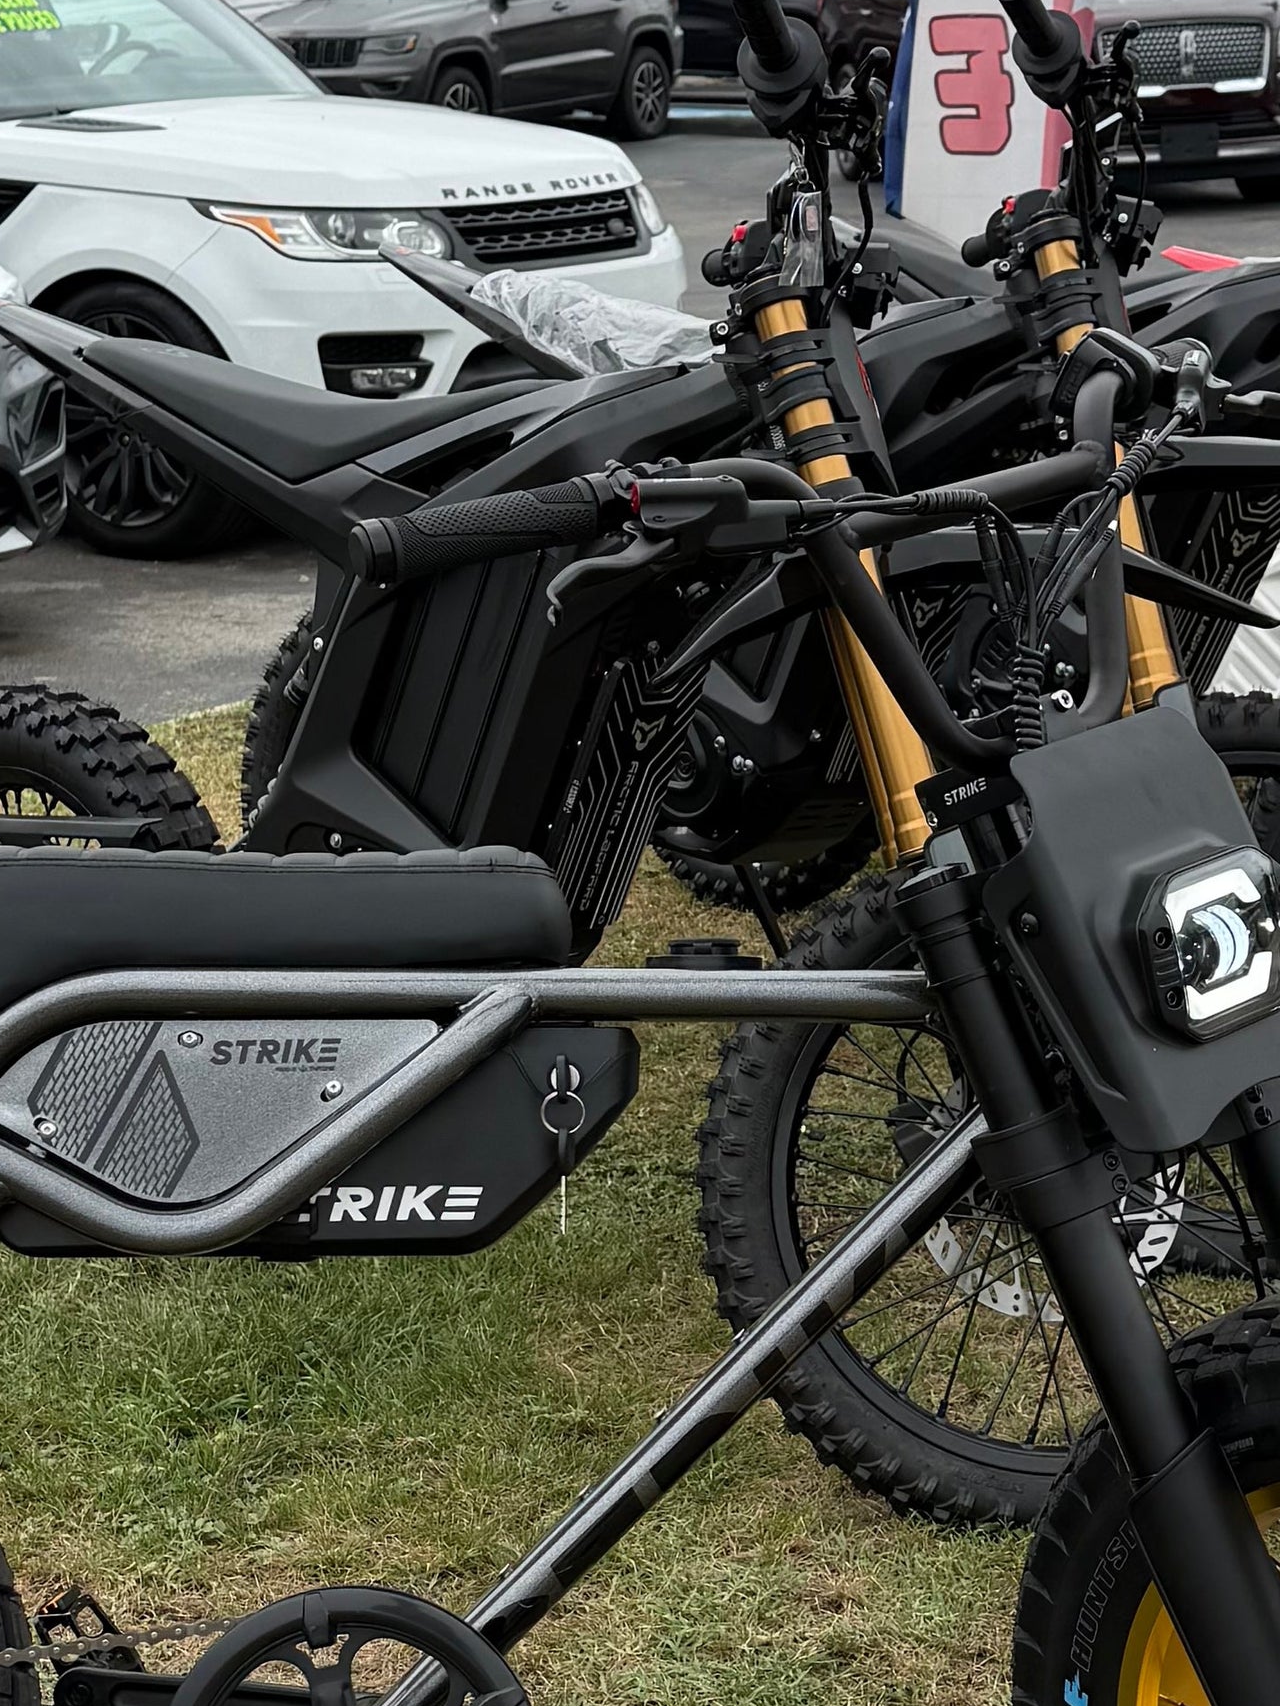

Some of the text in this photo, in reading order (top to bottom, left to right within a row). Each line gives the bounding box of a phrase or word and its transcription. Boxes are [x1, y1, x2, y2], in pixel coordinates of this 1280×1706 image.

[441, 173, 619, 199] RANGE ROVER
[943, 777, 987, 805] STRIKE
[209, 1038, 342, 1065] STRIKE
[298, 1185, 484, 1222] TRIKE
[1070, 1520, 1137, 1673] HUNTS
